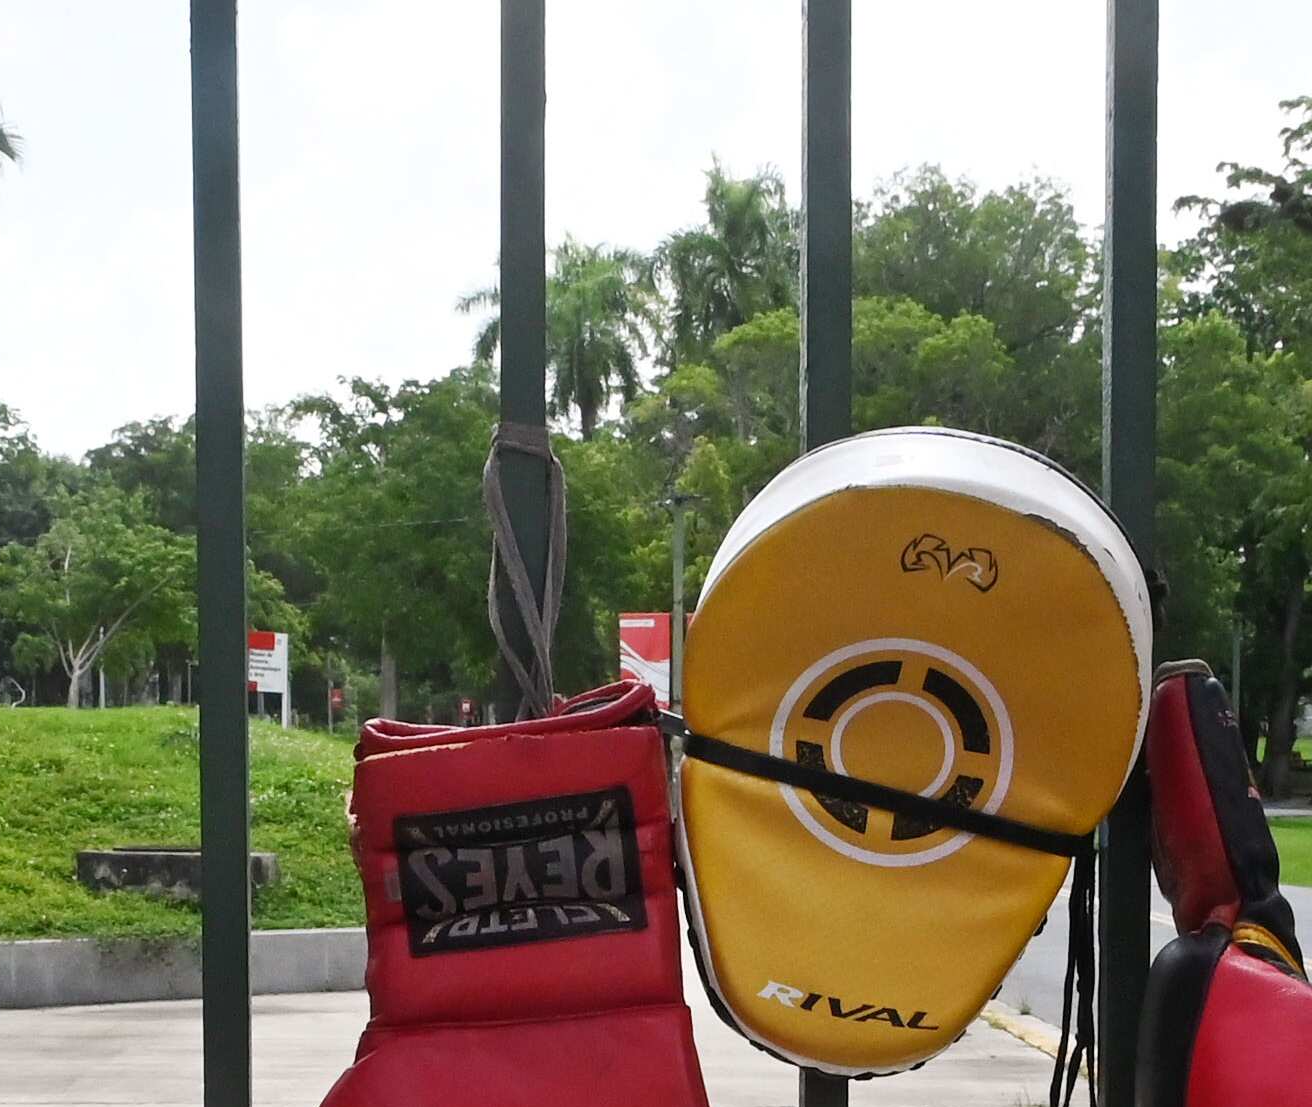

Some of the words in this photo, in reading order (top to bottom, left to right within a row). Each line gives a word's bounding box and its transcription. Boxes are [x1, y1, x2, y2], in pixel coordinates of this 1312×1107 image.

[432, 808, 589, 839] PROFESIONAL
[407, 812, 626, 919] REYES
[756, 980, 939, 1030] RIVAL
